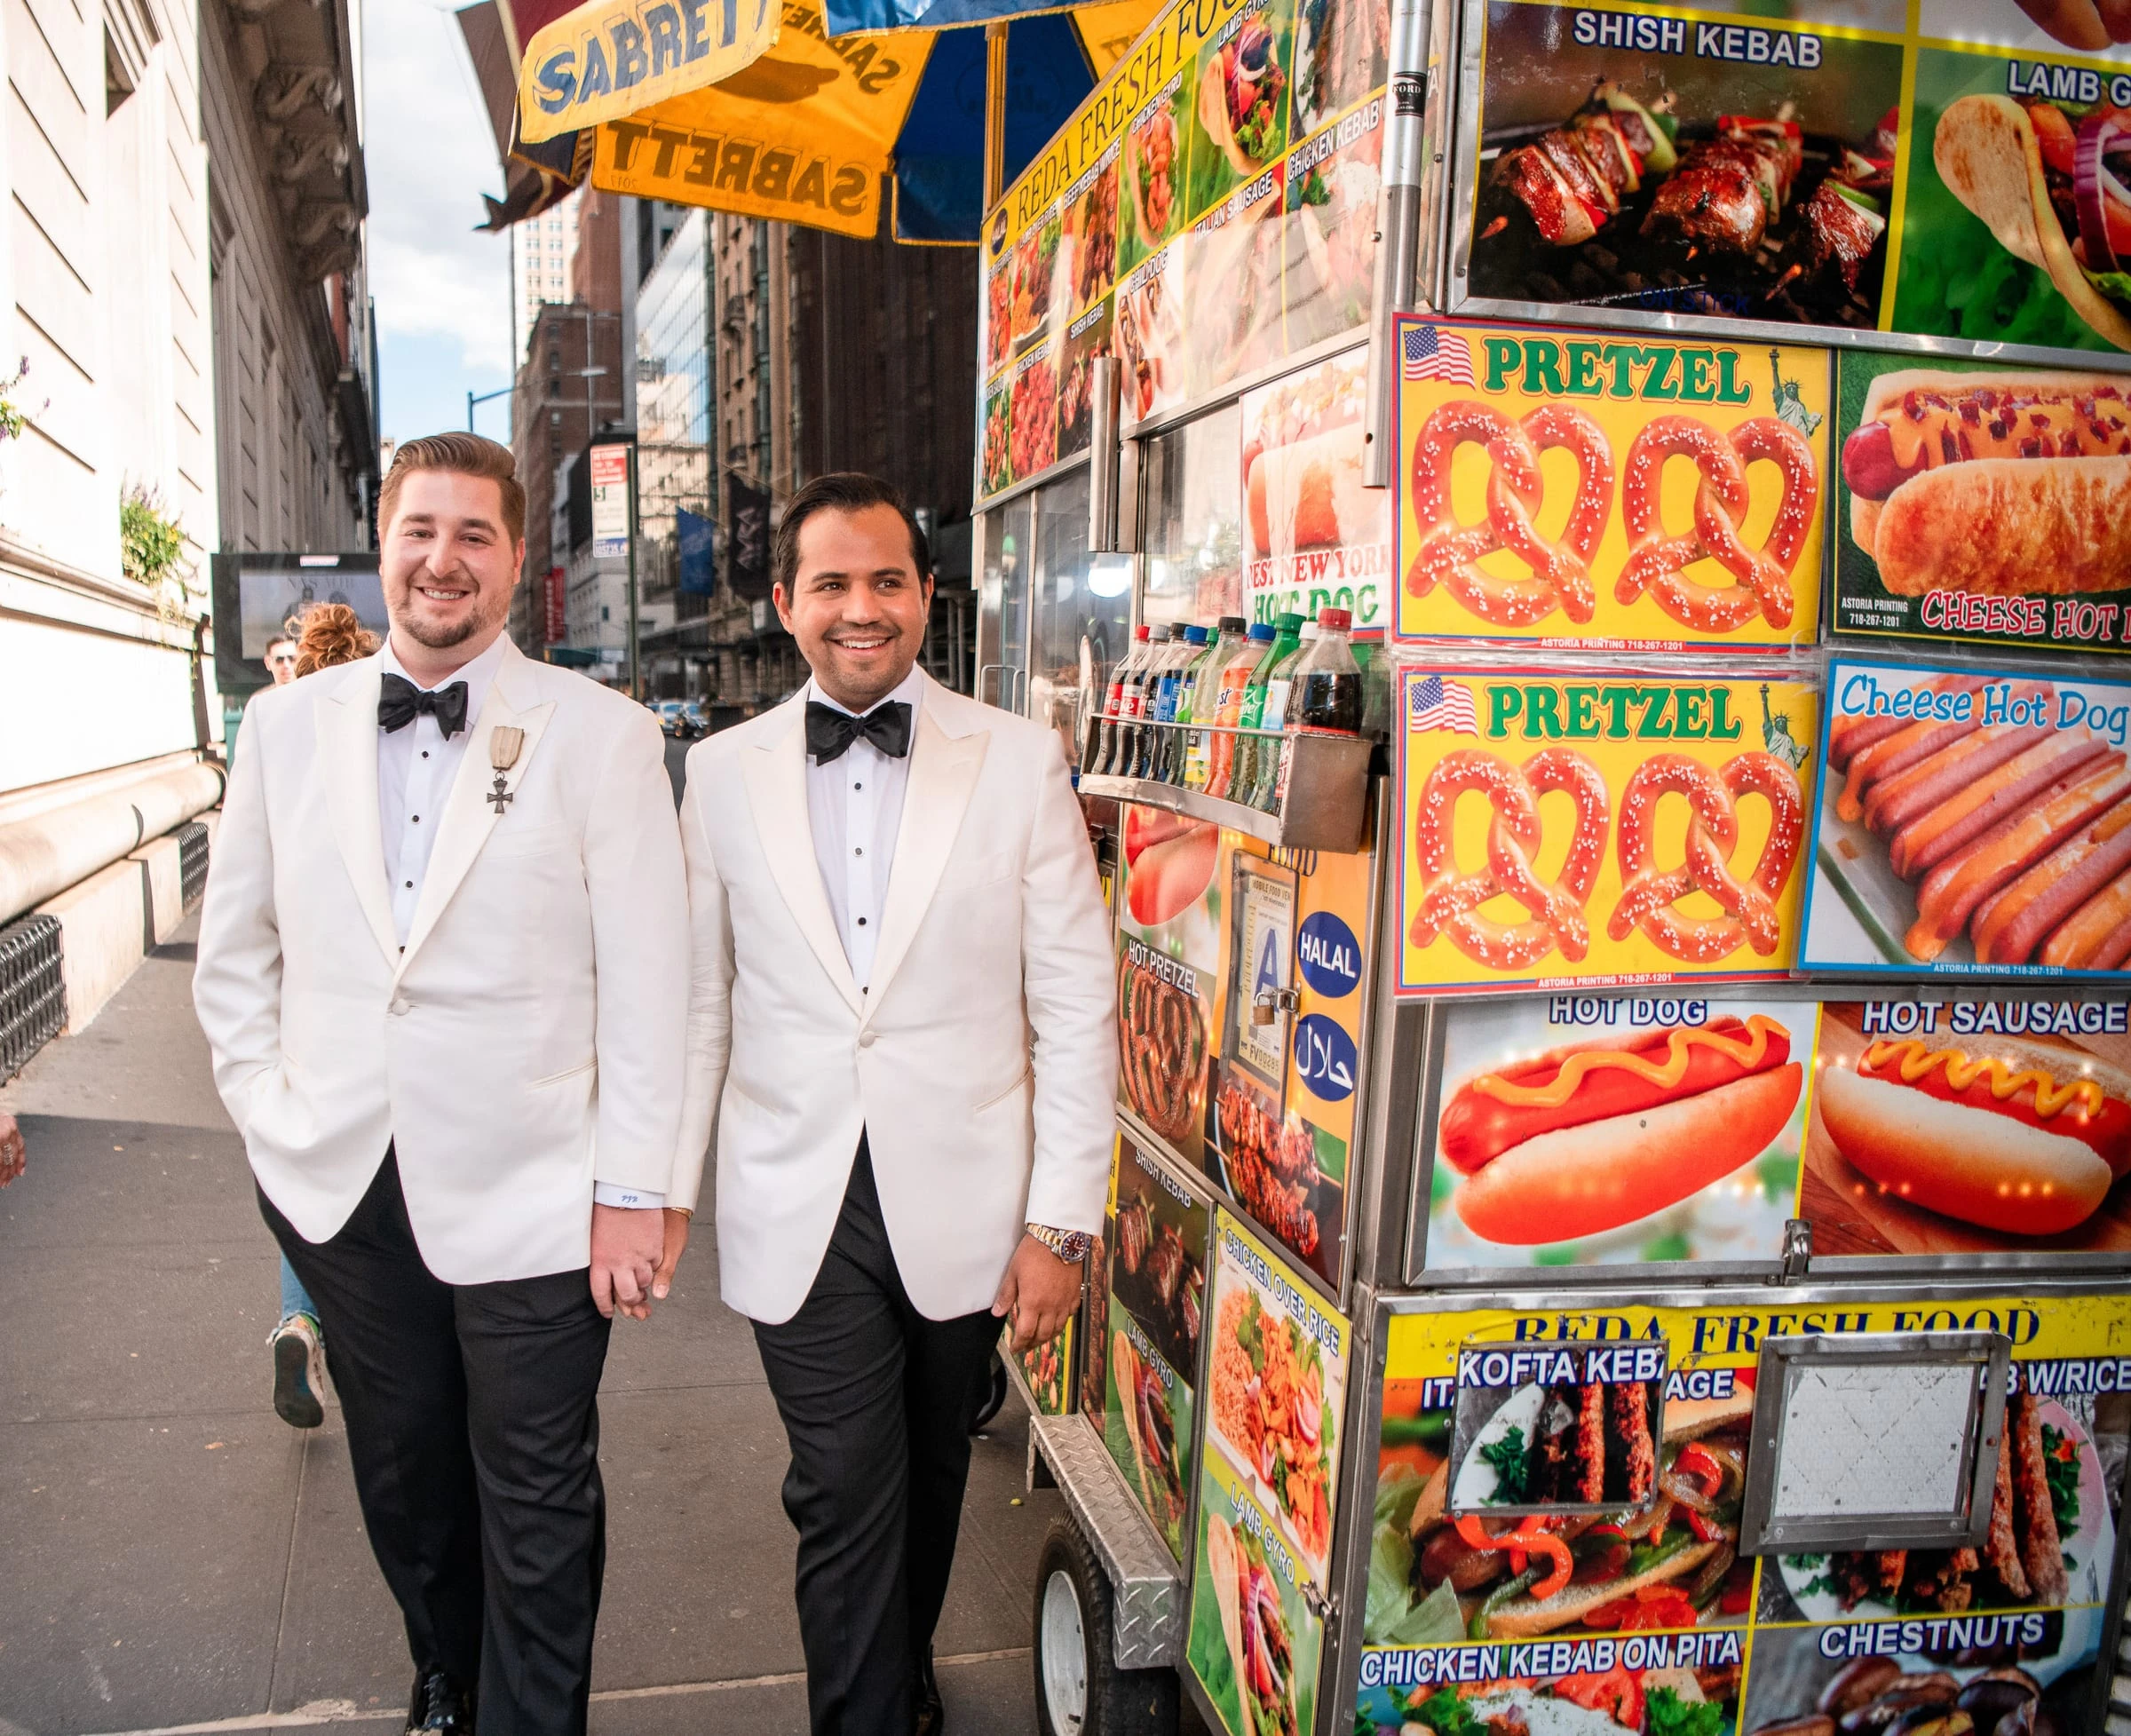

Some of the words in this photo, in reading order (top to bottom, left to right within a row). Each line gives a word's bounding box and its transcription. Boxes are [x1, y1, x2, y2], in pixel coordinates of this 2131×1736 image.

[1217, 9, 1242, 50] LAMB
[1244, 0, 1268, 21] GYR
[1573, 12, 1684, 53] SHISH
[1697, 25, 1822, 68] KEBAB
[539, 0, 766, 114] SABRET
[2008, 60, 2100, 104] LAMB
[1017, 139, 1071, 232] REDA
[1080, 28, 1166, 167] FRESH
[1173, 0, 1237, 65] FO
[1131, 99, 1160, 134] CHICKEN
[1161, 70, 1182, 106] GYRO
[1287, 130, 1334, 183] CHICKEN
[1335, 99, 1380, 154] KEBAB
[1194, 202, 1225, 243] ITALIAN
[1226, 170, 1272, 218] SAUSAGE
[1150, 246, 1168, 282] DOG
[1070, 321, 1087, 340] SHISH
[1086, 303, 1105, 329] KEBAB
[1484, 337, 1751, 404] PRETZEL
[1308, 584, 1378, 623] DOG
[1842, 597, 1873, 610] ASTORIA
[1874, 598, 1908, 613] PRINTING
[1850, 614, 1899, 627] 718-267-1201
[1921, 590, 2046, 634] CHEESE
[2053, 601, 2118, 640] HOT
[1541, 638, 1580, 649] ASTORIA
[1581, 638, 1626, 650] PRINTING
[1627, 639, 1683, 651] 718-267-1201
[1488, 686, 1742, 741] PRETZEL
[1841, 674, 1972, 721] Cheese
[1982, 684, 2047, 725] Hot
[2056, 691, 2129, 744] Dog
[1129, 939, 1148, 971] HOT
[1149, 952, 1200, 1000] PRETZEL
[1256, 929, 1279, 1014] A
[1300, 932, 1357, 979] HALAL
[1538, 977, 1574, 987] ASTORIA
[1576, 975, 1616, 986] PRINTING
[1618, 973, 1672, 985] 718-267-1201
[1934, 963, 1969, 974] ASTORIA
[1971, 964, 2010, 975] PRINTING
[2012, 965, 2064, 976] 718-267-1201
[1549, 998, 1623, 1025] HOT
[1630, 998, 1707, 1026] DOG
[1863, 1002, 1944, 1033] HOT
[1951, 1002, 2127, 1034] SAUSAGE
[1295, 1024, 1354, 1090] حلال
[1136, 1148, 1159, 1180] SHISH
[1161, 1171, 1192, 1209] KEBAB
[1225, 1227, 1271, 1293] CHICKEN
[1273, 1273, 1306, 1325] OVER
[1309, 1312, 1339, 1357] RICE
[1126, 1316, 1147, 1354] LAMB
[1149, 1342, 1173, 1391] GYRO
[1460, 1351, 1577, 1386] KOFTA
[2027, 1361, 2131, 1394] W/RICE
[1422, 1377, 1454, 1409] IT
[1230, 1482, 1263, 1541] LAMB
[1264, 1525, 1295, 1585] GYRO
[1360, 1646, 1505, 1687] CHICKEN
[1508, 1640, 1614, 1678] KEBAB
[1623, 1637, 1669, 1669] ON
[1676, 1631, 1741, 1668] PITA
[1820, 1613, 2044, 1658] CHESTNUTS
